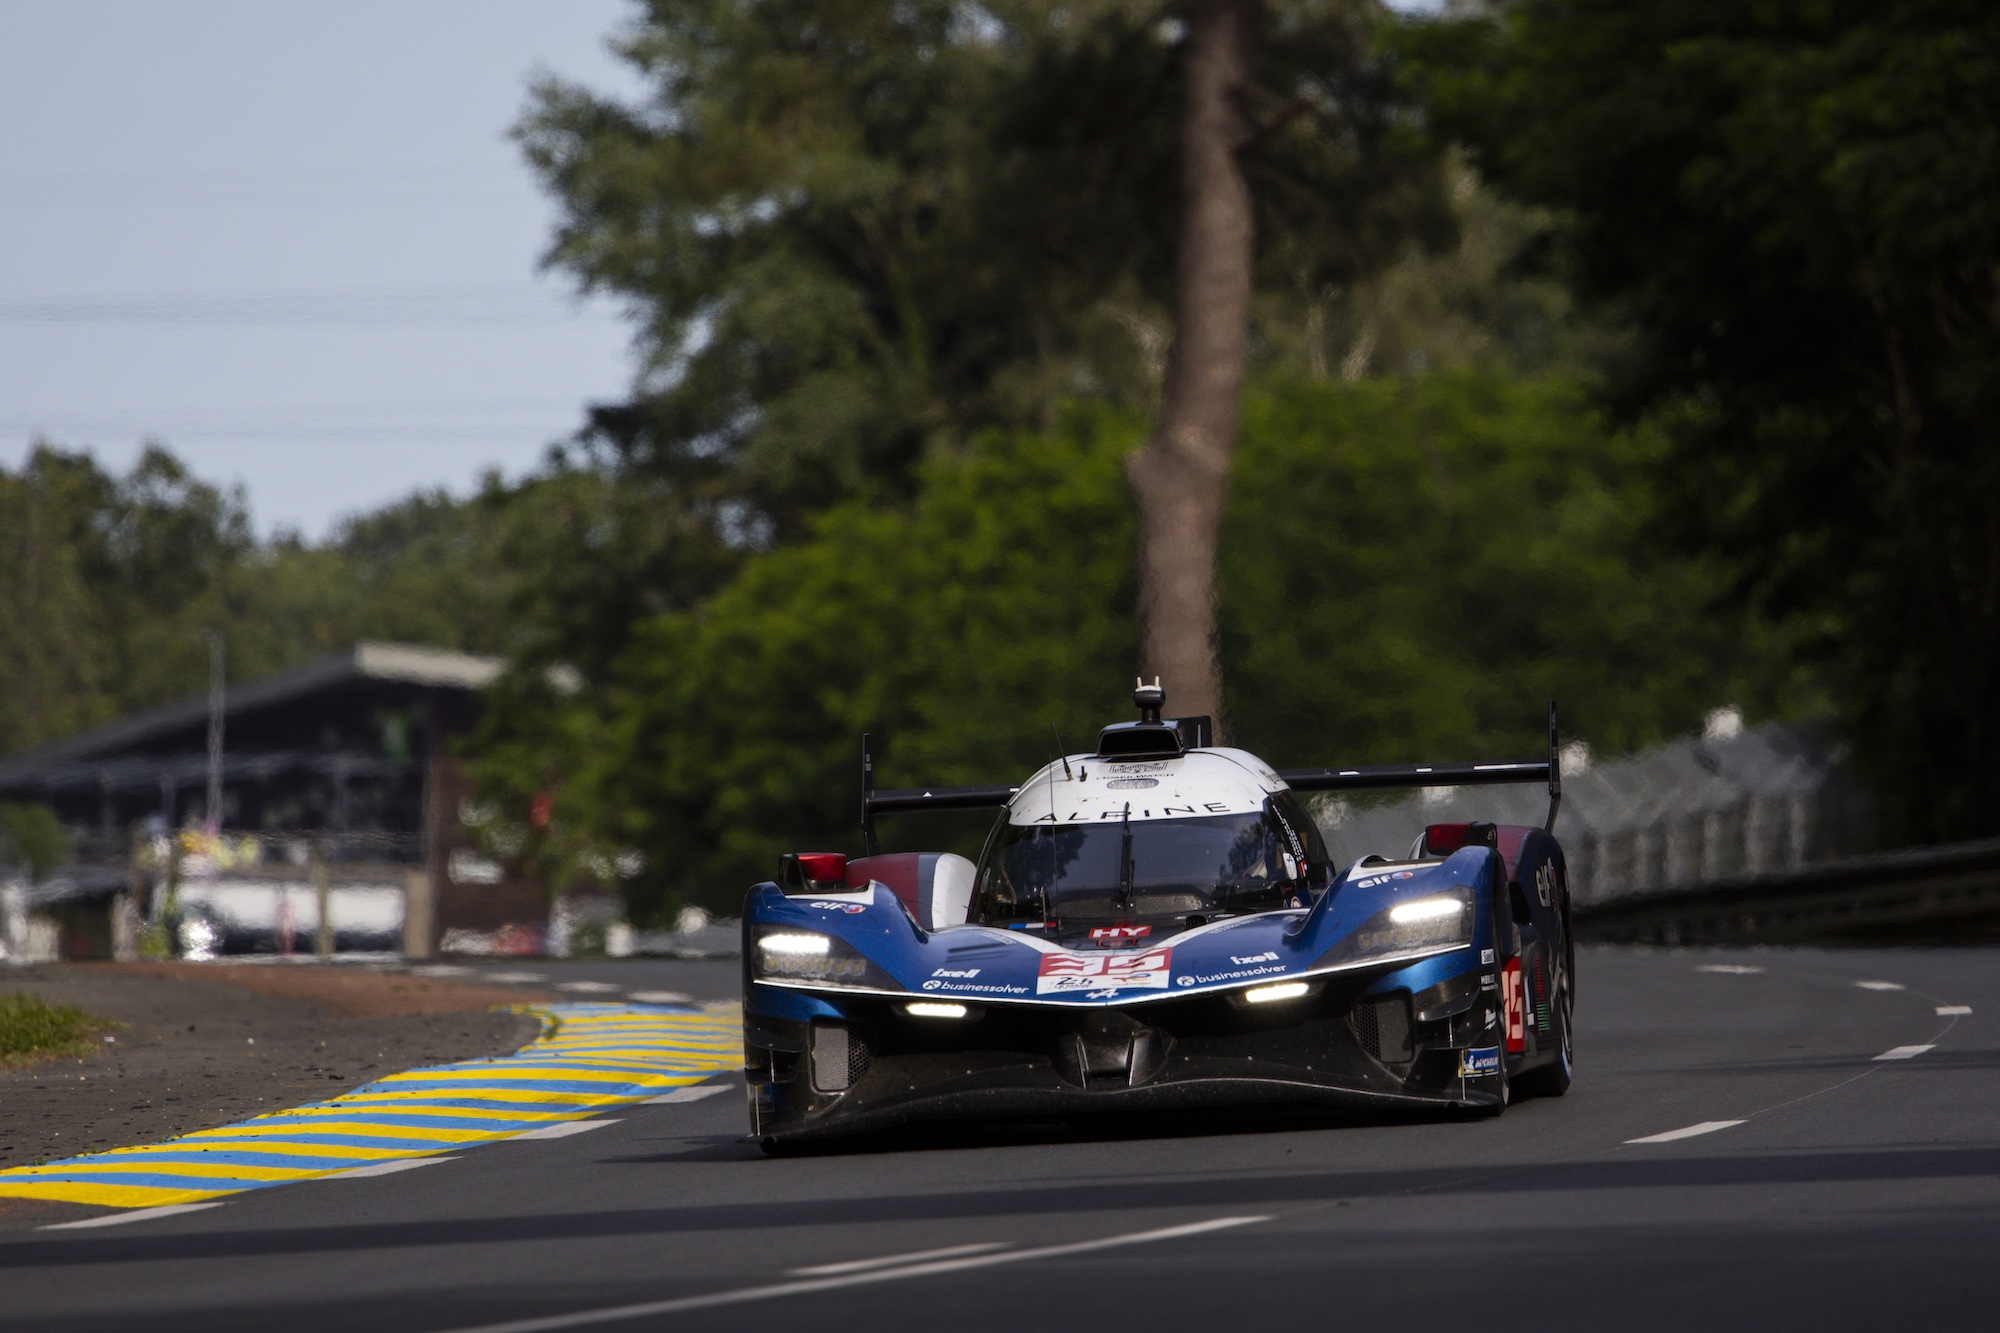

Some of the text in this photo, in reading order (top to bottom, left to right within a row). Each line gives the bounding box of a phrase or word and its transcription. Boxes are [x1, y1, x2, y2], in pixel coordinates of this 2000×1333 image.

[1033, 802, 1230, 822] ALPINE
[1092, 926, 1143, 938] HY
[1230, 951, 1280, 966] ixell
[1196, 964, 1287, 984] businessolver
[942, 981, 1029, 994] businessolver
